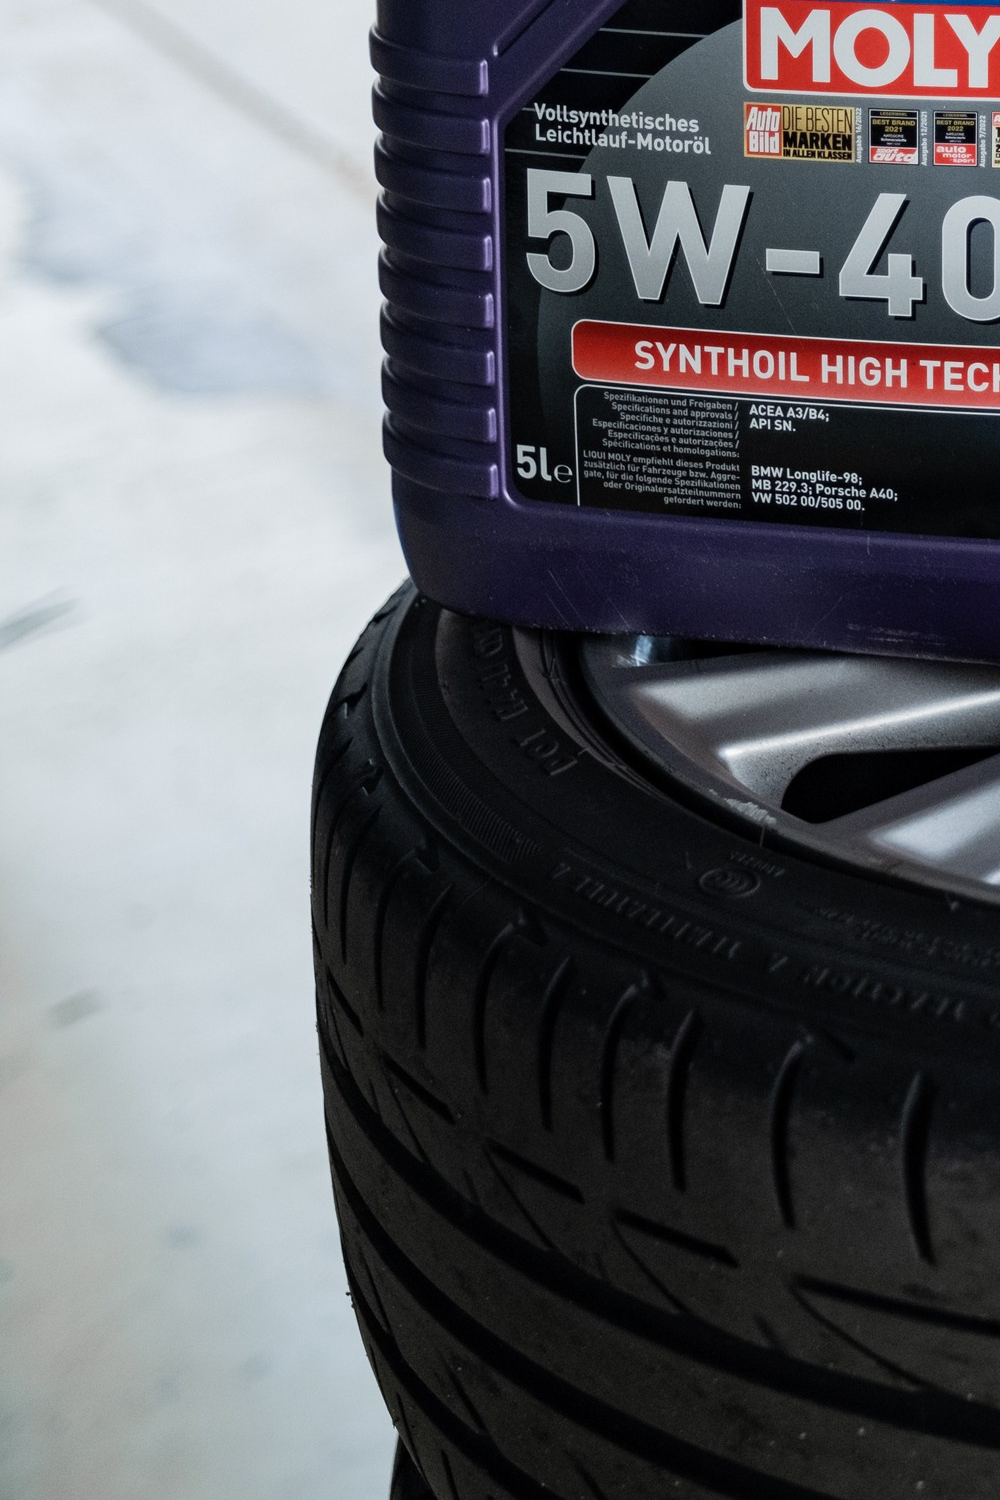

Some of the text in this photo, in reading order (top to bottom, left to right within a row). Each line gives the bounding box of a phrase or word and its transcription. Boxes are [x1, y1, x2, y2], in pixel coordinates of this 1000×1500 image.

[534, 103, 700, 133] Vollsynthetisches
[746, 106, 781, 131] Auto
[783, 106, 853, 133] DIE BESTEN
[535, 123, 712, 155] Leichtlauf-Motoröl
[749, 131, 780, 153] Bild
[783, 131, 852, 151] MARKEN
[783, 149, 852, 160] IN ALLEN KLASSEN
[634, 341, 809, 382] SYNTHOIL
[821, 354, 908, 389] HIGH
[604, 392, 669, 406] Spezifikationen
[671, 398, 687, 407] und
[689, 399, 733, 411] Freigaben
[612, 402, 671, 415] Specifications
[672, 408, 688, 416] and
[690, 409, 733, 421] approvals
[620, 412, 664, 424] Specifiche
[672, 418, 733, 429] autorizzazioni
[749, 404, 829, 422] ACEA A3/B4;
[592, 418, 662, 433] Especificaciones
[670, 427, 734, 439] autorizaciones
[749, 418, 796, 431] API SN.
[583, 450, 740, 471] LIQUI MOLY empfiehlt dieses Produkt
[663, 444, 671, 452] et
[673, 446, 740, 458] homologations:
[583, 460, 740, 481] zusätzlich für Fahrzeuge bzw. Aggre-
[583, 470, 741, 490] gate, für die folgende Spezifikationen
[751, 465, 862, 485] BMW Longlife-98;
[603, 480, 741, 499] oder Originalersatzteilnummern
[751, 479, 898, 501] MB 229.3; Porsche A40;
[664, 495, 741, 509] gefordert werden:
[752, 492, 865, 511] VW 502 00/505 00.
